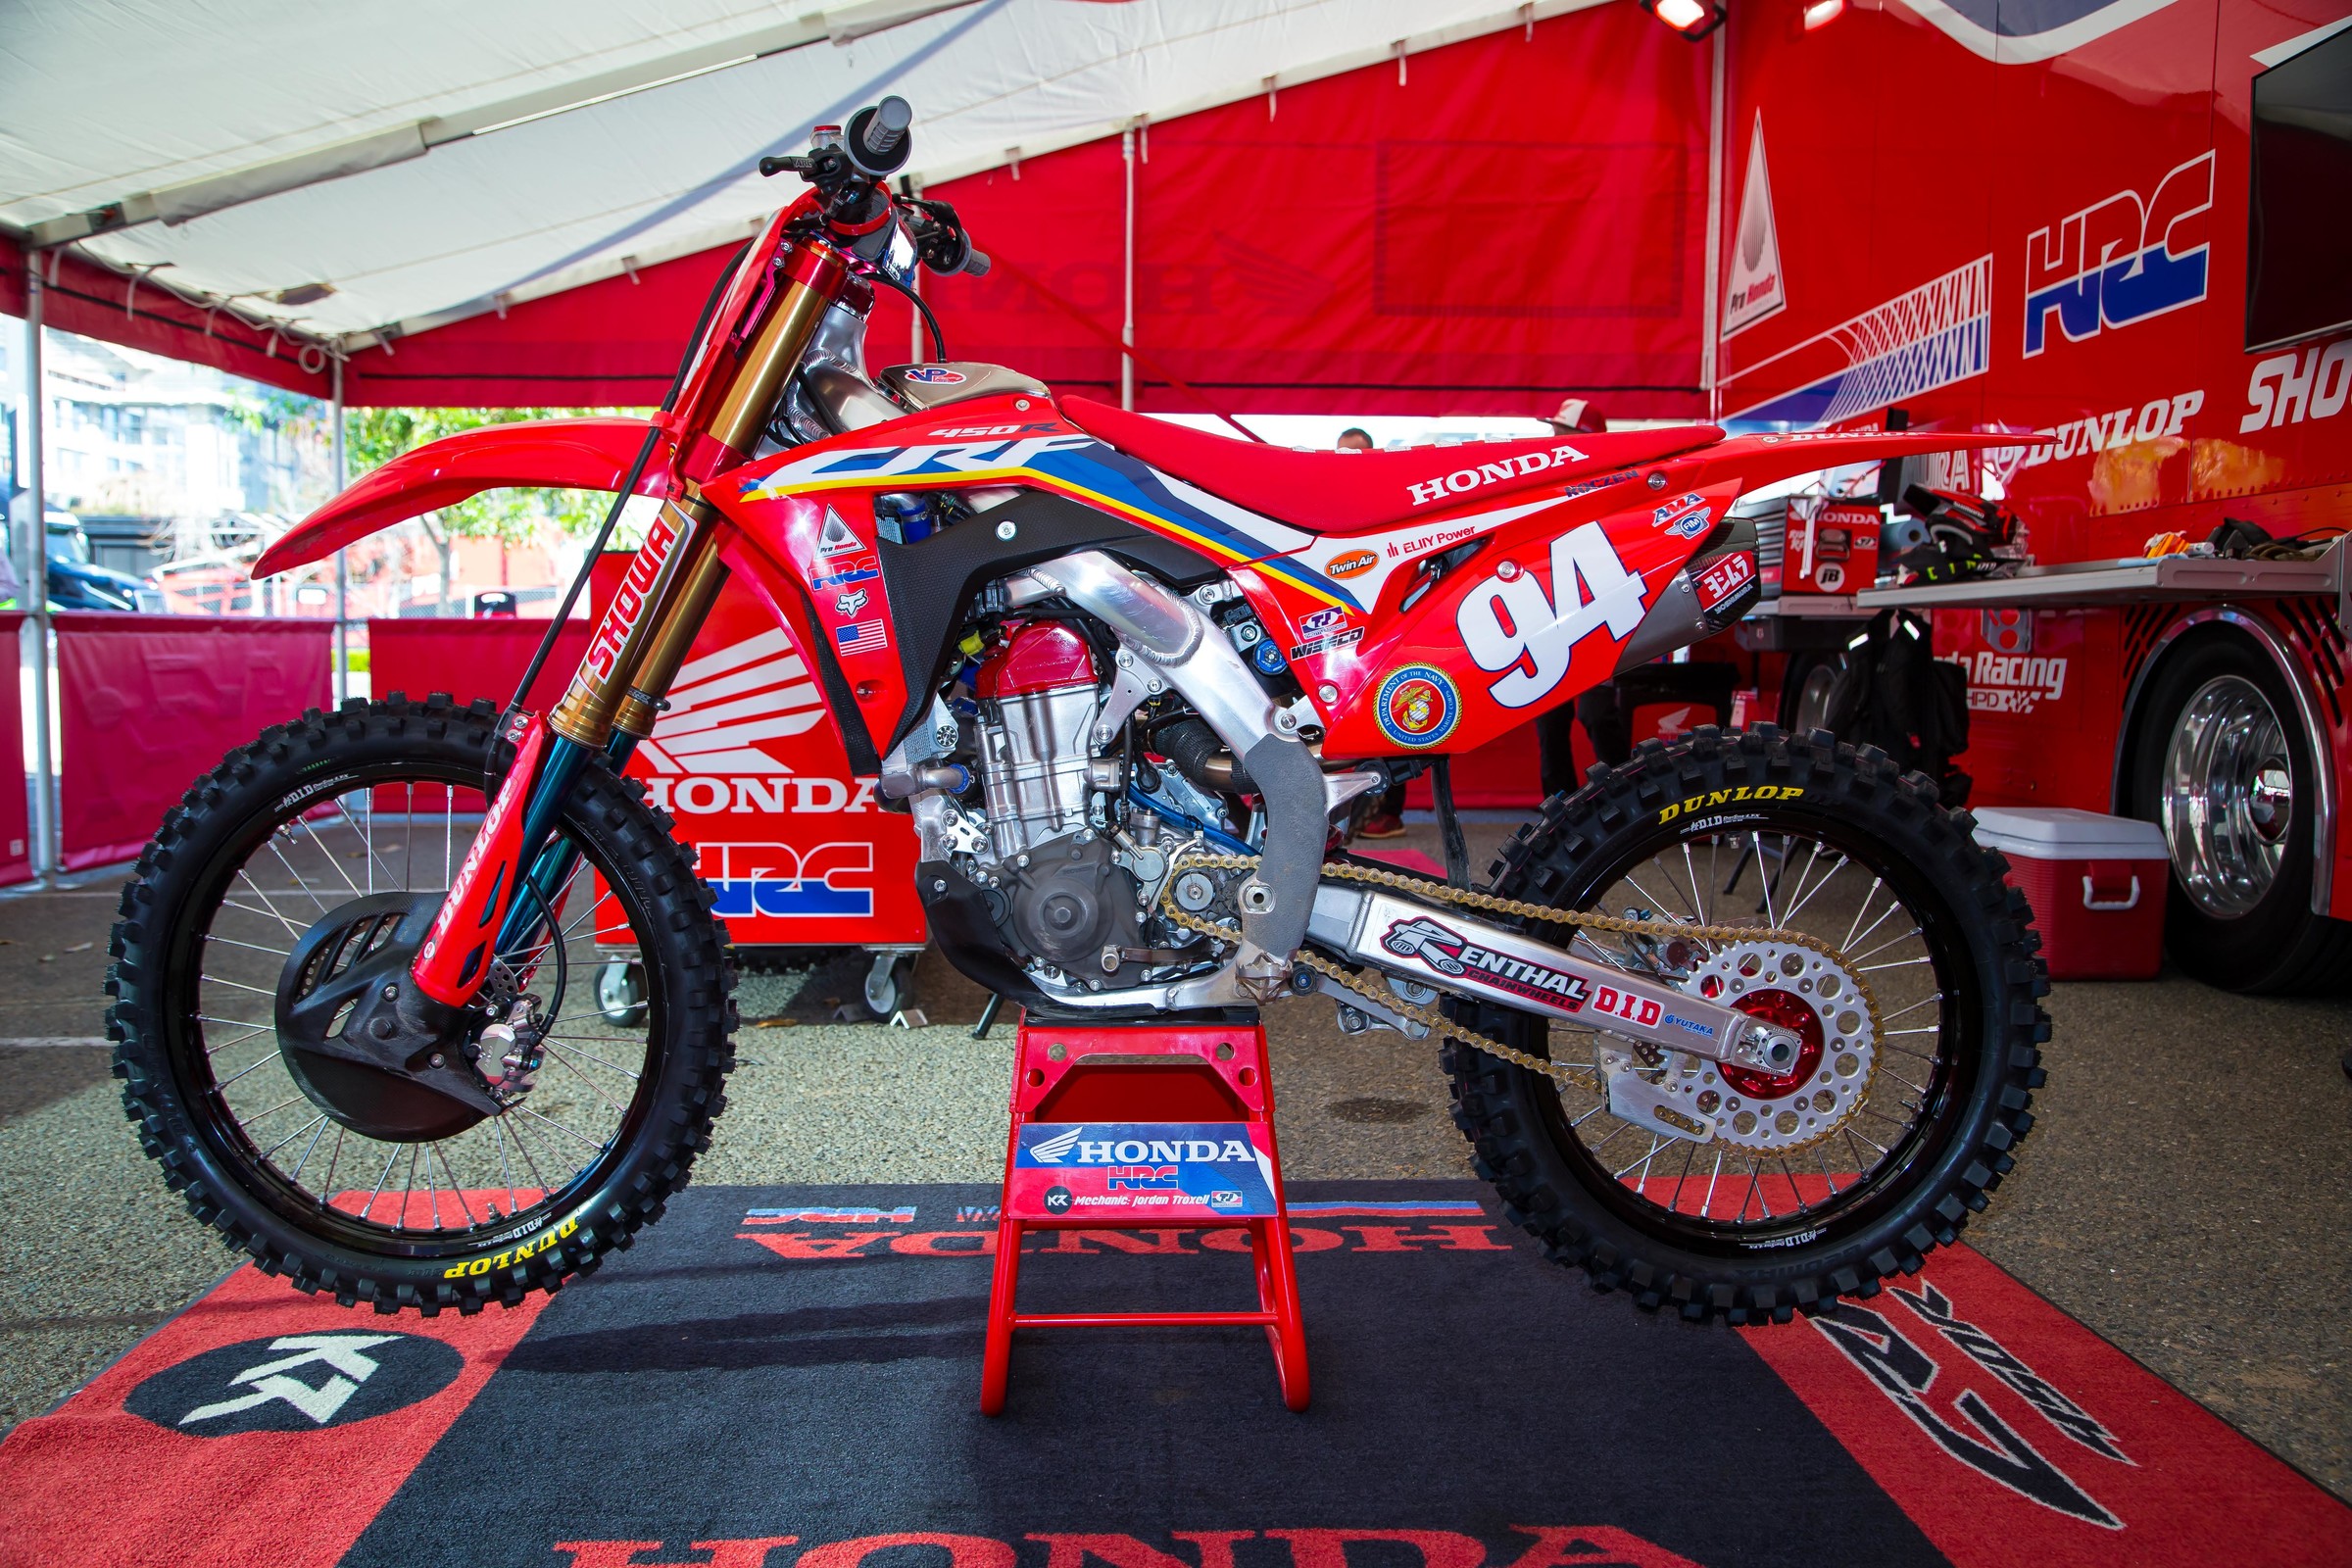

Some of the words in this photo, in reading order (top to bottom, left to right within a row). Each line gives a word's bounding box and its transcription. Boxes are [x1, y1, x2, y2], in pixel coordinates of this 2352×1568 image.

[2023, 148, 2216, 360] HRC
[907, 368, 948, 382] VP
[2238, 338, 2352, 434] SHO
[927, 422, 1061, 438] 450R
[2026, 390, 2204, 467] DUNLOP
[760, 433, 1106, 490] CRF
[1406, 445, 1590, 507] HONDA
[1652, 493, 1706, 527] AMA
[1683, 517, 1702, 532] FIM
[834, 540, 858, 551] Honda
[1436, 525, 1476, 544] Power
[808, 555, 880, 591] HRC
[1329, 561, 1358, 576] Twin
[1356, 553, 1378, 568] Air
[585, 513, 680, 686] SHOWA
[1456, 520, 1648, 710] 94
[1714, 583, 1754, 615] YOSHIMURA
[1311, 610, 1333, 628] TJ
[1973, 651, 2069, 701] Racing
[1380, 677, 1400, 727] DEPARTMENT
[1424, 671, 1445, 686] NAVY
[1393, 729, 1417, 742] UNITED
[1417, 732, 1440, 743] STATES
[1438, 710, 1454, 733] MARINE
[1446, 690, 1454, 710] CORPS
[641, 776, 888, 814] HONDA
[1658, 785, 1804, 825] DUNLOP
[439, 776, 513, 937] DUNLOP
[1468, 968, 1581, 1011] CHAINWHEELS
[1593, 985, 1663, 1028] D.I.D
[1674, 1016, 1715, 1035] YUTAKA
[1077, 1140, 1256, 1163] HONDA
[1107, 1165, 1179, 1191] HRC
[1074, 1196, 1130, 1206] Mechanic:
[1131, 1194, 1169, 1207] Jordan
[1172, 1194, 1209, 1205] Troxell
[444, 1215, 579, 1279] DUNLOP
[734, 1224, 1512, 1260] HONDA
